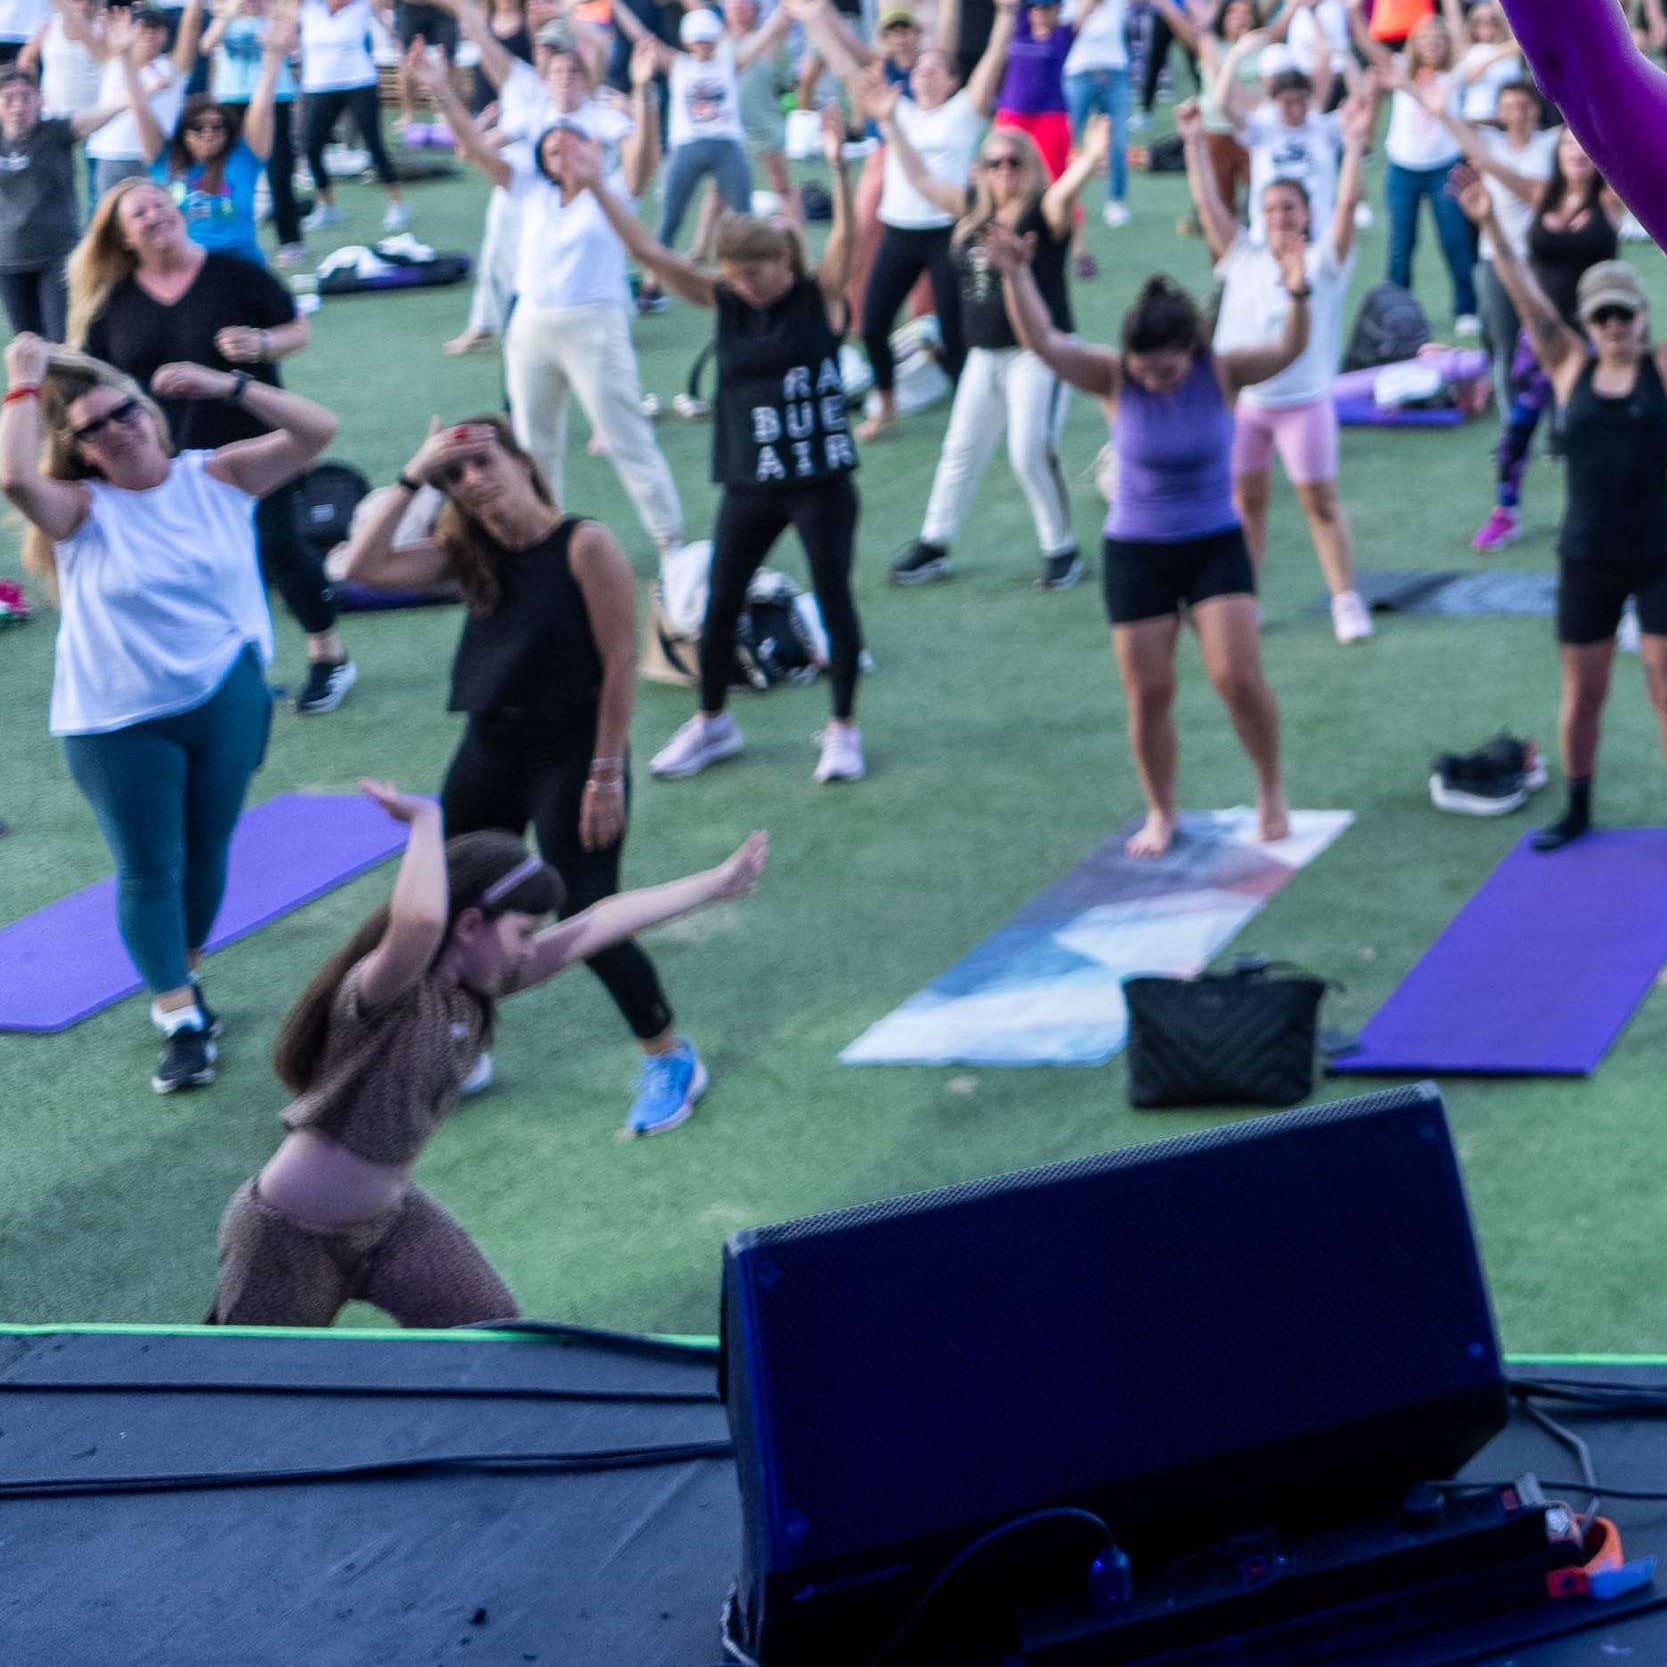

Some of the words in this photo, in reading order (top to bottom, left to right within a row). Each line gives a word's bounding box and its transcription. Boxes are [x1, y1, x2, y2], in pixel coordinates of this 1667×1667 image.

[783, 357, 843, 401] RA
[751, 394, 849, 443] BUE
[756, 434, 856, 481] AIR
